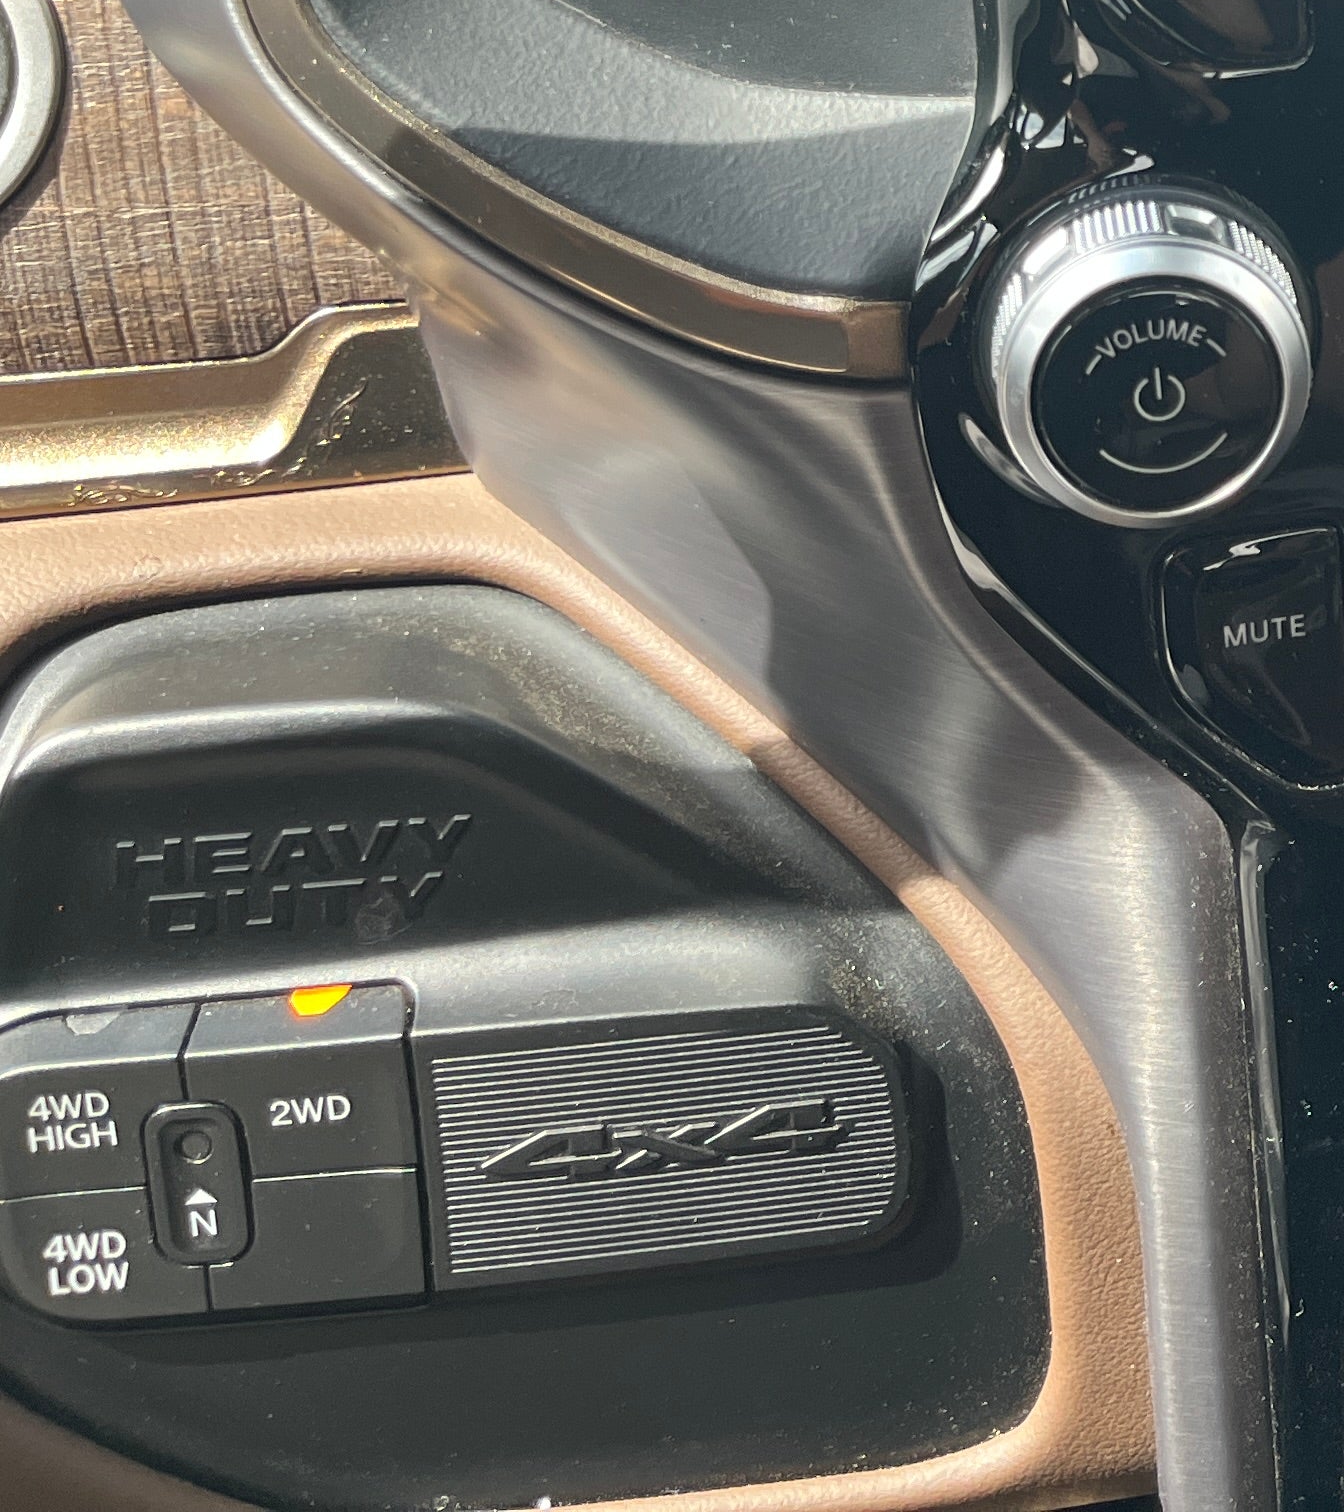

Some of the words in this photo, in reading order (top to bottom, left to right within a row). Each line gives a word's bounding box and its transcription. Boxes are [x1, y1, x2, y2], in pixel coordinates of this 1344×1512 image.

[1094, 318, 1206, 360] VOLUME
[1222, 612, 1307, 649] MUTE
[112, 812, 474, 890] HEAVY
[144, 869, 445, 940] DUTY
[26, 1091, 111, 1124] 4WD
[269, 1094, 352, 1128] 2WD
[26, 1122, 120, 1154] HIGH
[189, 1208, 219, 1238] N
[42, 1229, 128, 1263] 4WD
[47, 1262, 131, 1296] LOW
